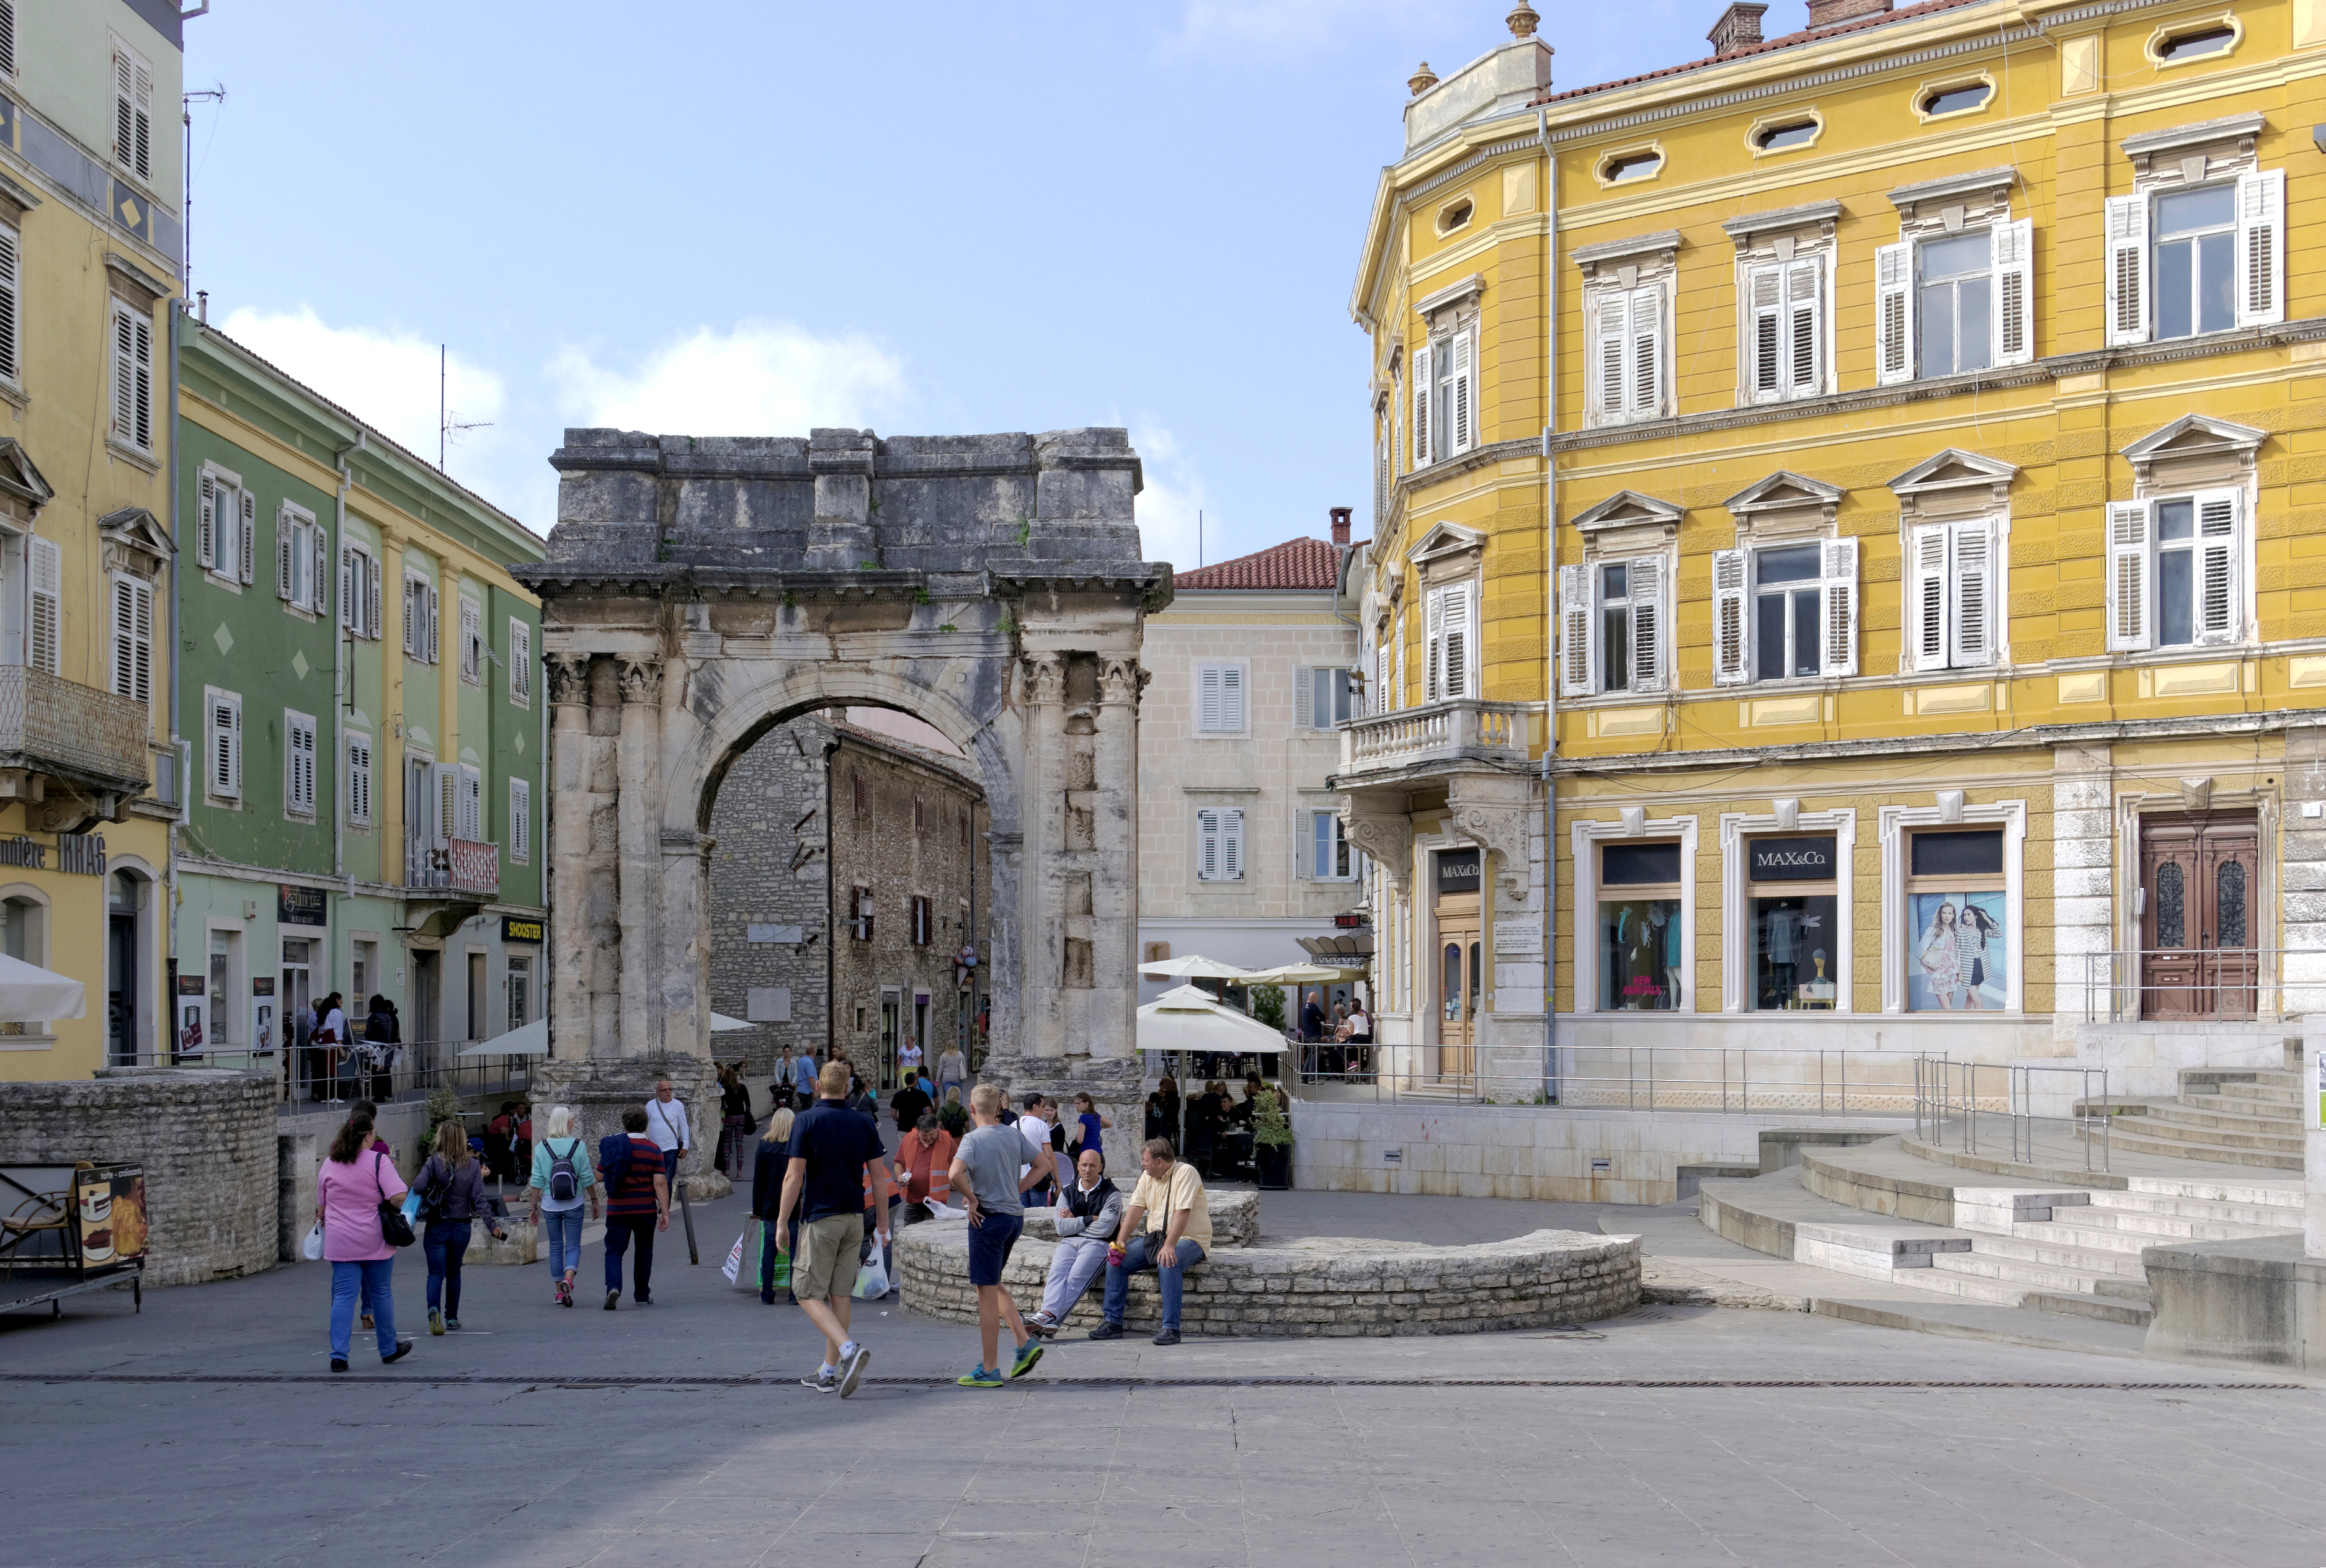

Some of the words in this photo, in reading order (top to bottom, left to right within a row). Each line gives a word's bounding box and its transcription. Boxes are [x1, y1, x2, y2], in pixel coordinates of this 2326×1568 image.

[509, 921, 541, 939] SHOOSTER
[1633, 975, 1651, 985] NEW
[1623, 985, 1662, 995] ARRIVALS
